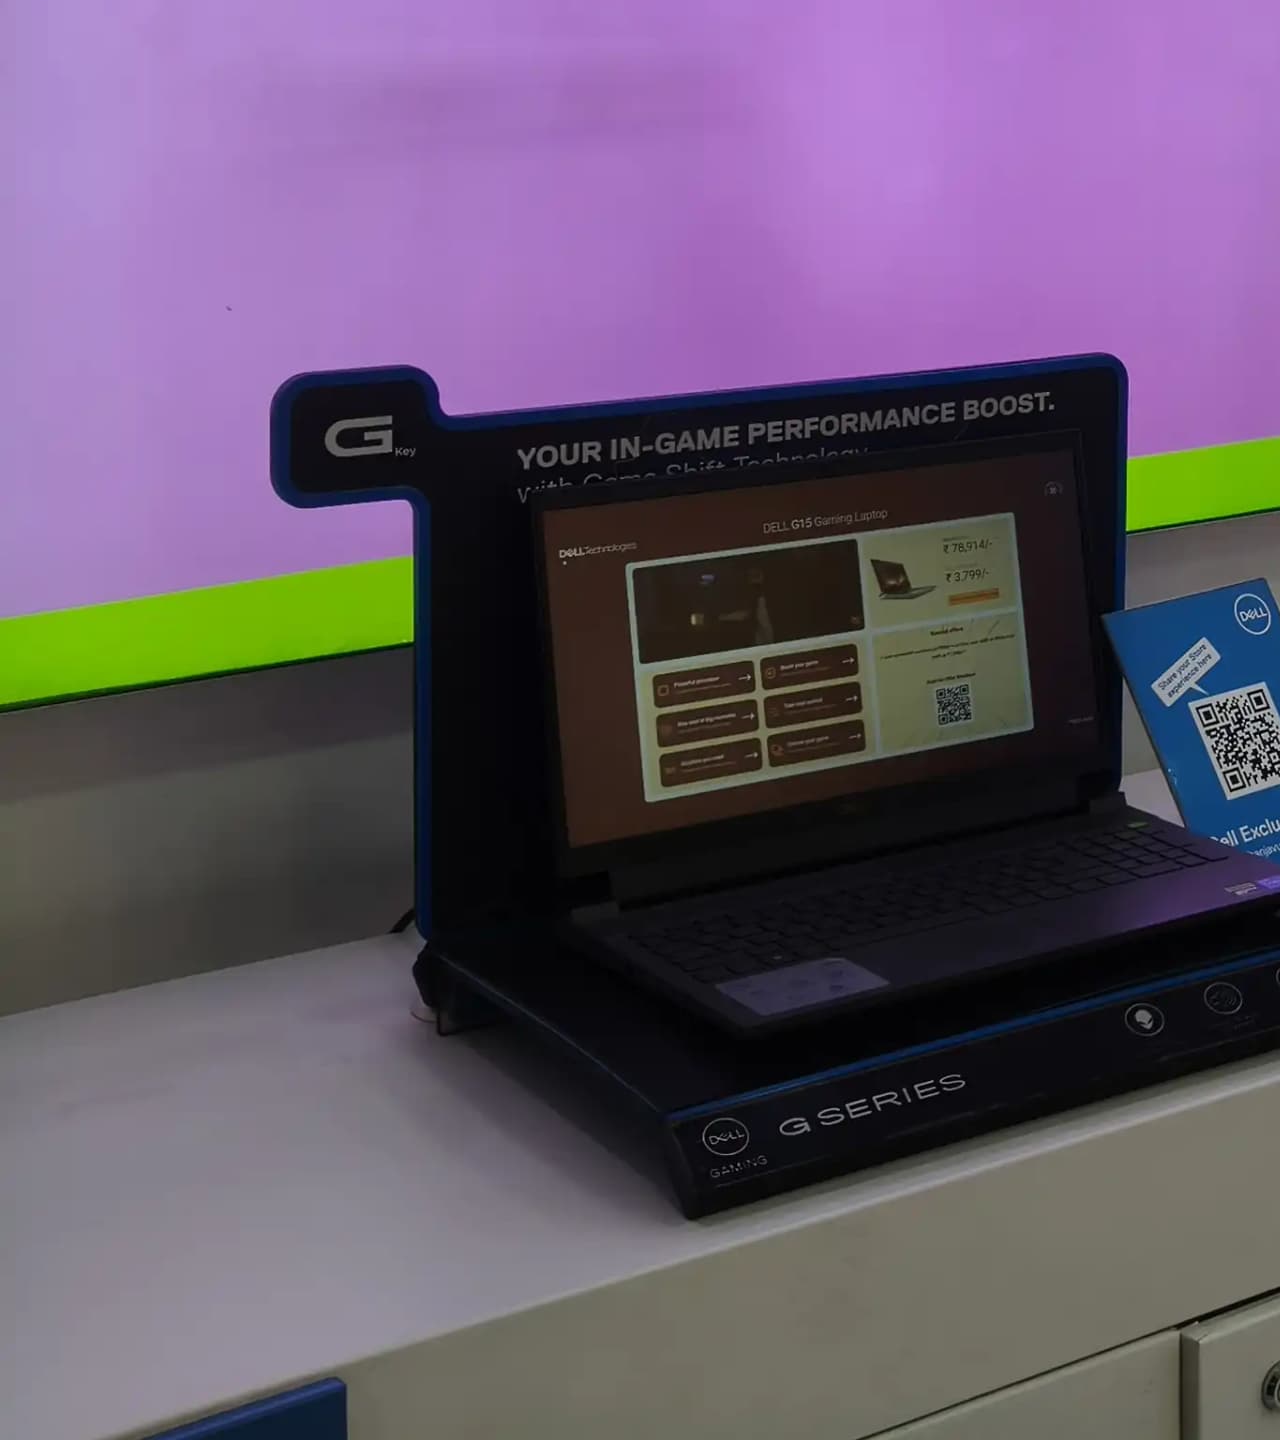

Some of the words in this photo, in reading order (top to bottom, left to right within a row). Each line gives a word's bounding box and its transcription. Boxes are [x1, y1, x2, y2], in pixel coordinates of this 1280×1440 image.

[517, 441, 602, 471] YOUR
[610, 426, 740, 462] IN-GAME
[747, 402, 956, 445] PERFORMANCE
[963, 392, 1056, 422] BOOST.
[395, 447, 416, 457] Key
[791, 517, 812, 530] G15
[1240, 607, 1267, 622] DELL
[778, 1117, 812, 1136] G
[816, 1073, 967, 1127] SERIES
[709, 1128, 745, 1145] DELL
